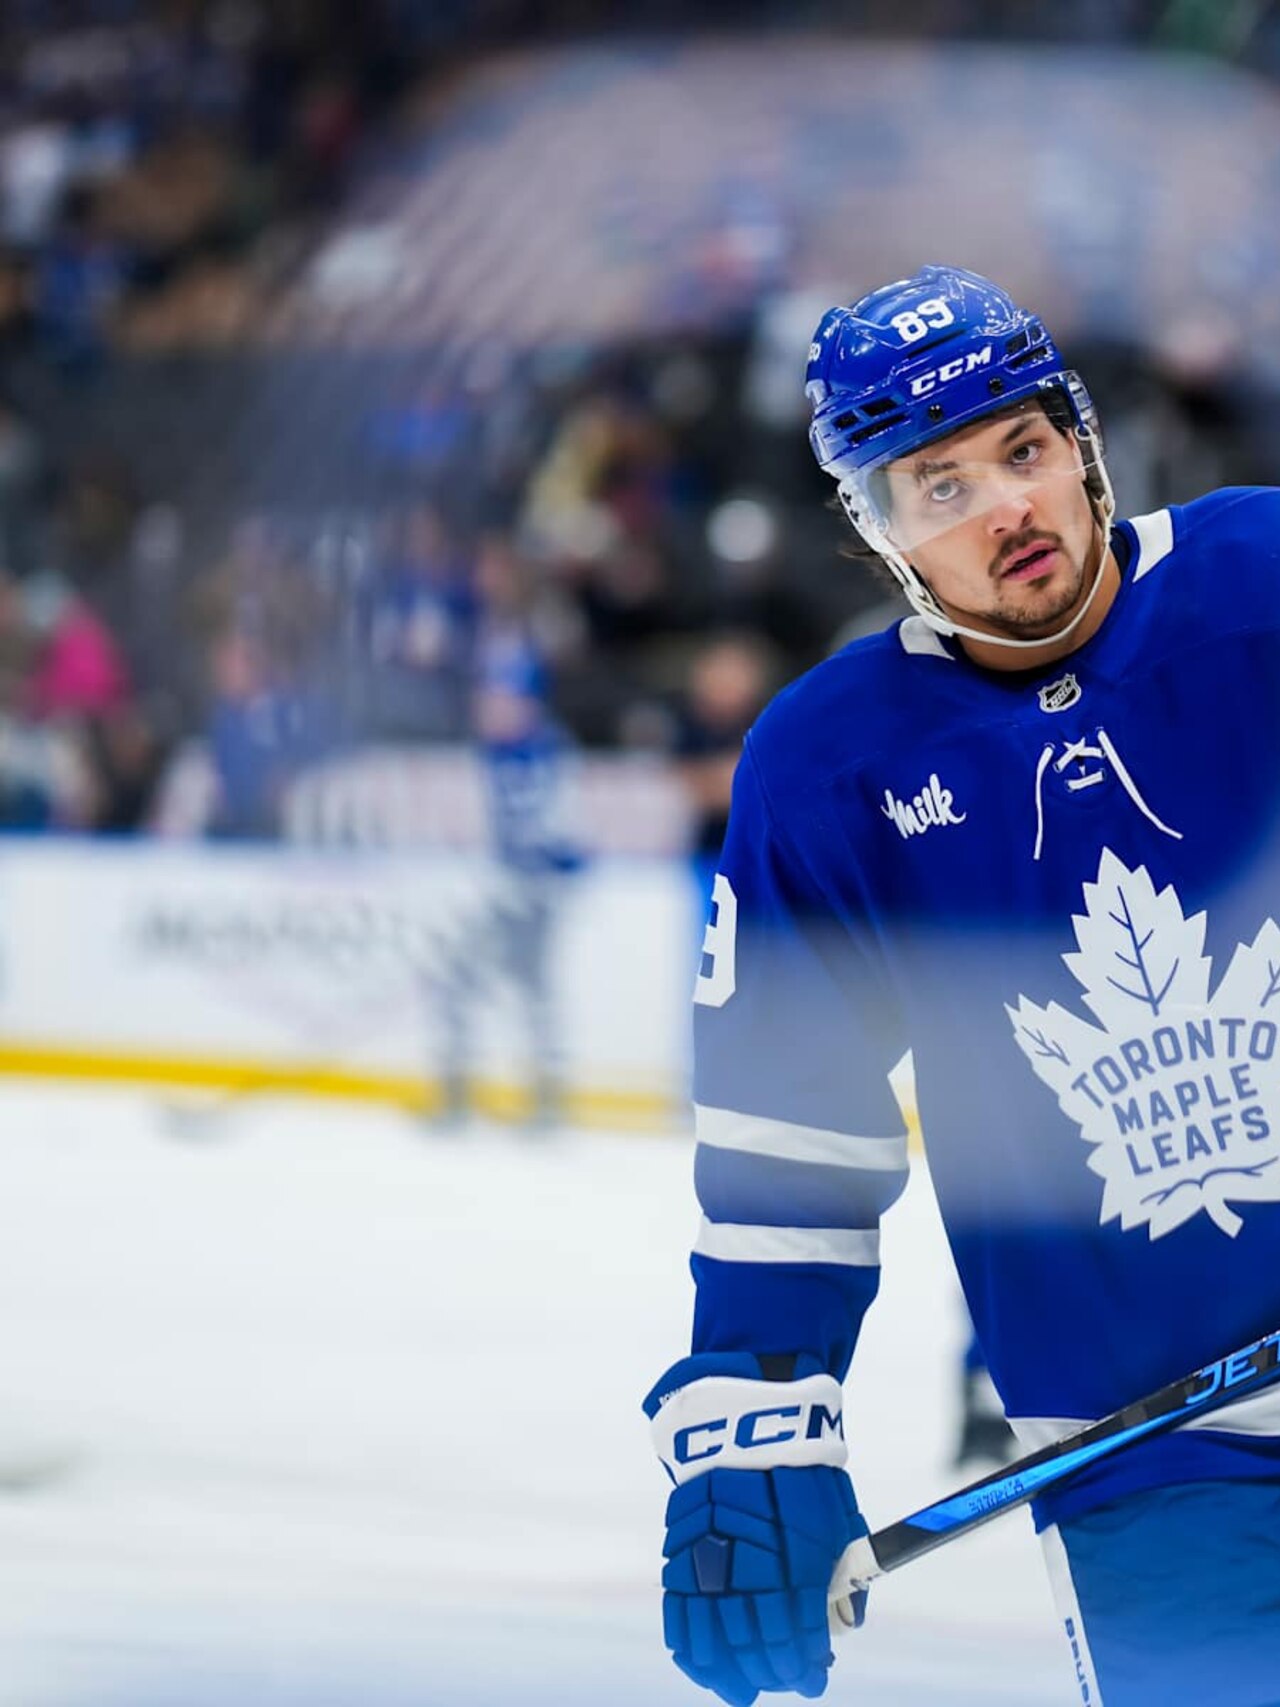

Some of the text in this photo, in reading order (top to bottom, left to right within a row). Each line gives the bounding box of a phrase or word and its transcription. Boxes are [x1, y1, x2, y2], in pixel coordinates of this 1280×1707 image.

[889, 298, 955, 343] 89
[909, 345, 993, 396] CCM
[1070, 1017, 1279, 1108] TORONTO
[1111, 1063, 1259, 1136] MAPLE
[1125, 1105, 1271, 1177] LEAFS
[673, 1403, 845, 1465] CCM
[1065, 1617, 1092, 1707] BAUE
